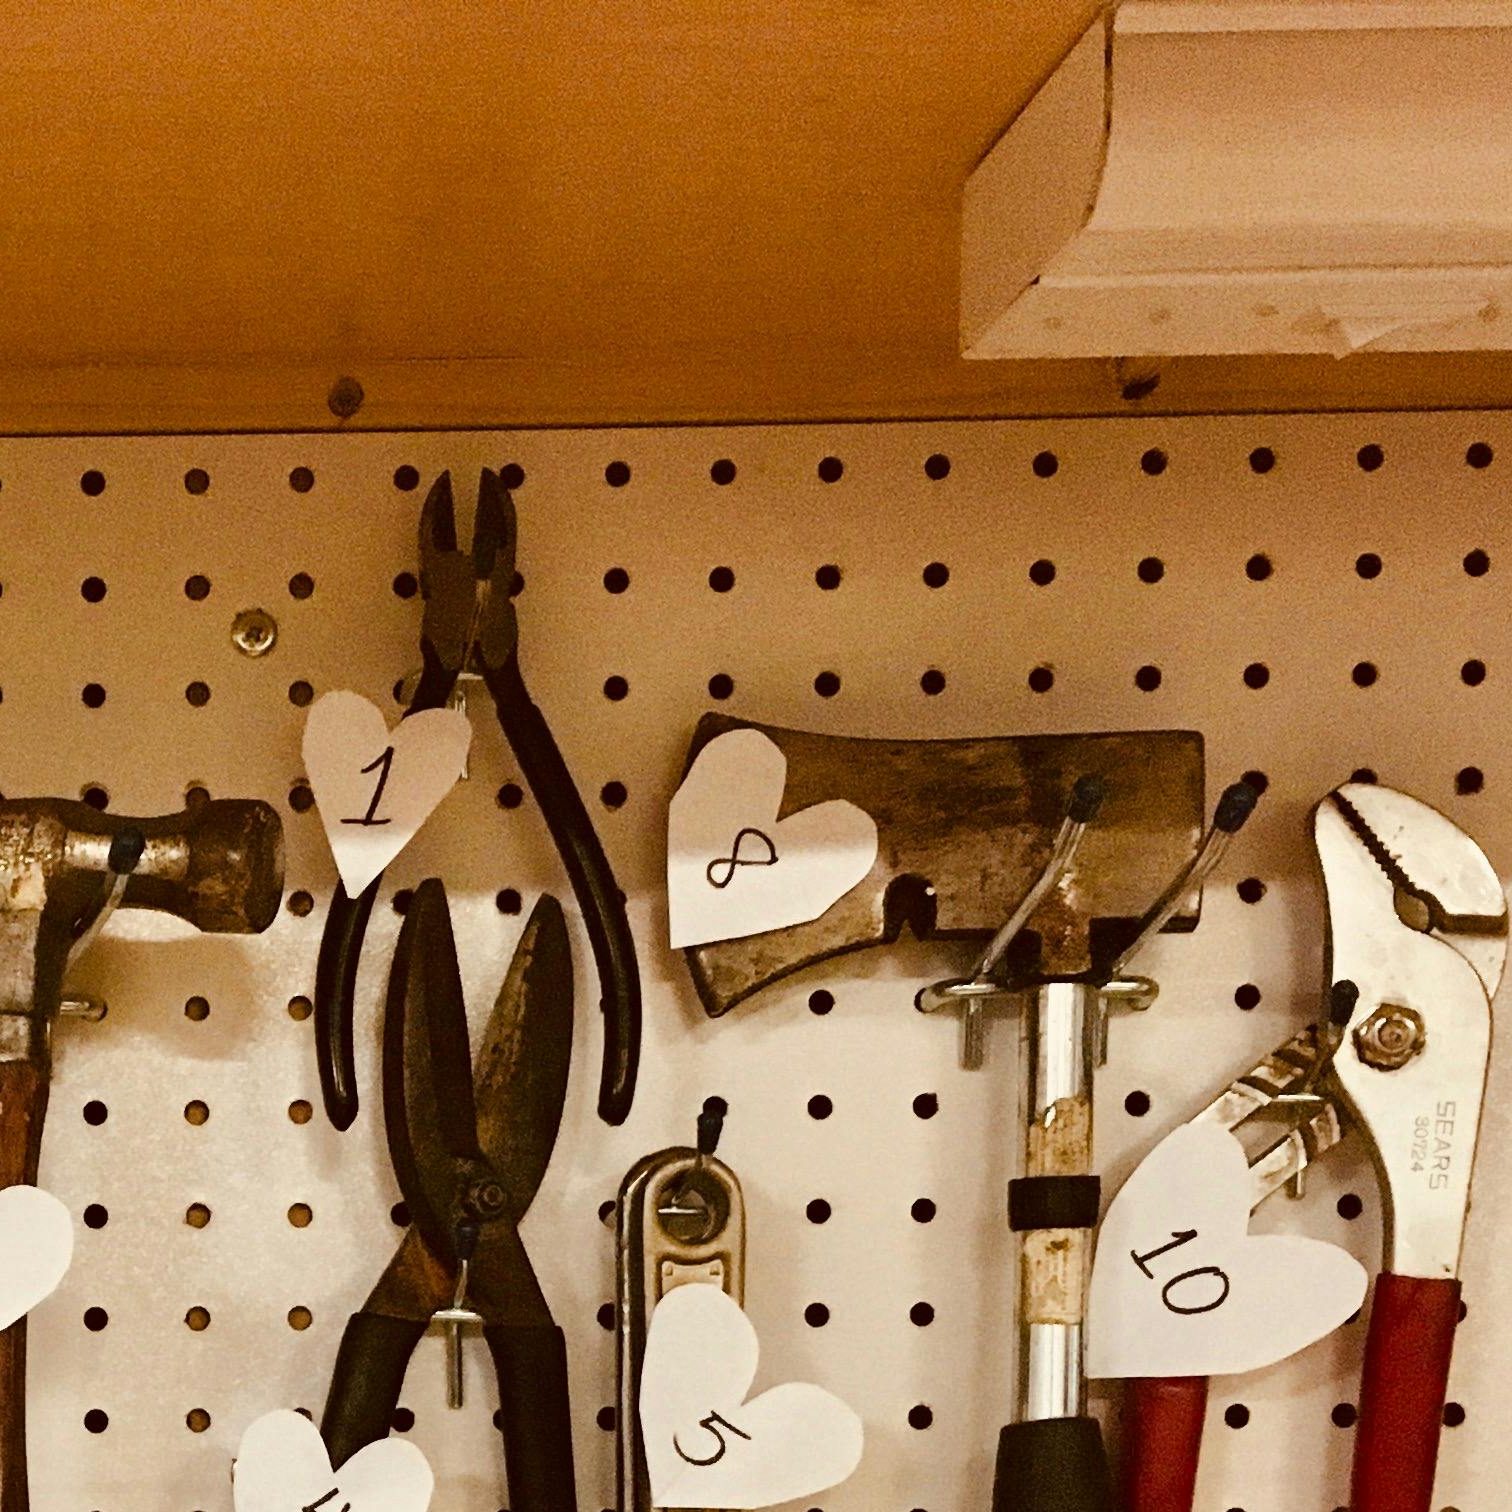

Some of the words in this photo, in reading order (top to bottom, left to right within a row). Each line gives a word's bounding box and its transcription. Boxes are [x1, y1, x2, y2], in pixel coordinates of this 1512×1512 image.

[340, 745, 395, 827] 1
[706, 827, 779, 889] 8
[1410, 1115, 1430, 1173] 30724
[1429, 1100, 1457, 1190] SEARS
[1130, 1229, 1230, 1316] 10
[673, 1409, 752, 1467] 5
